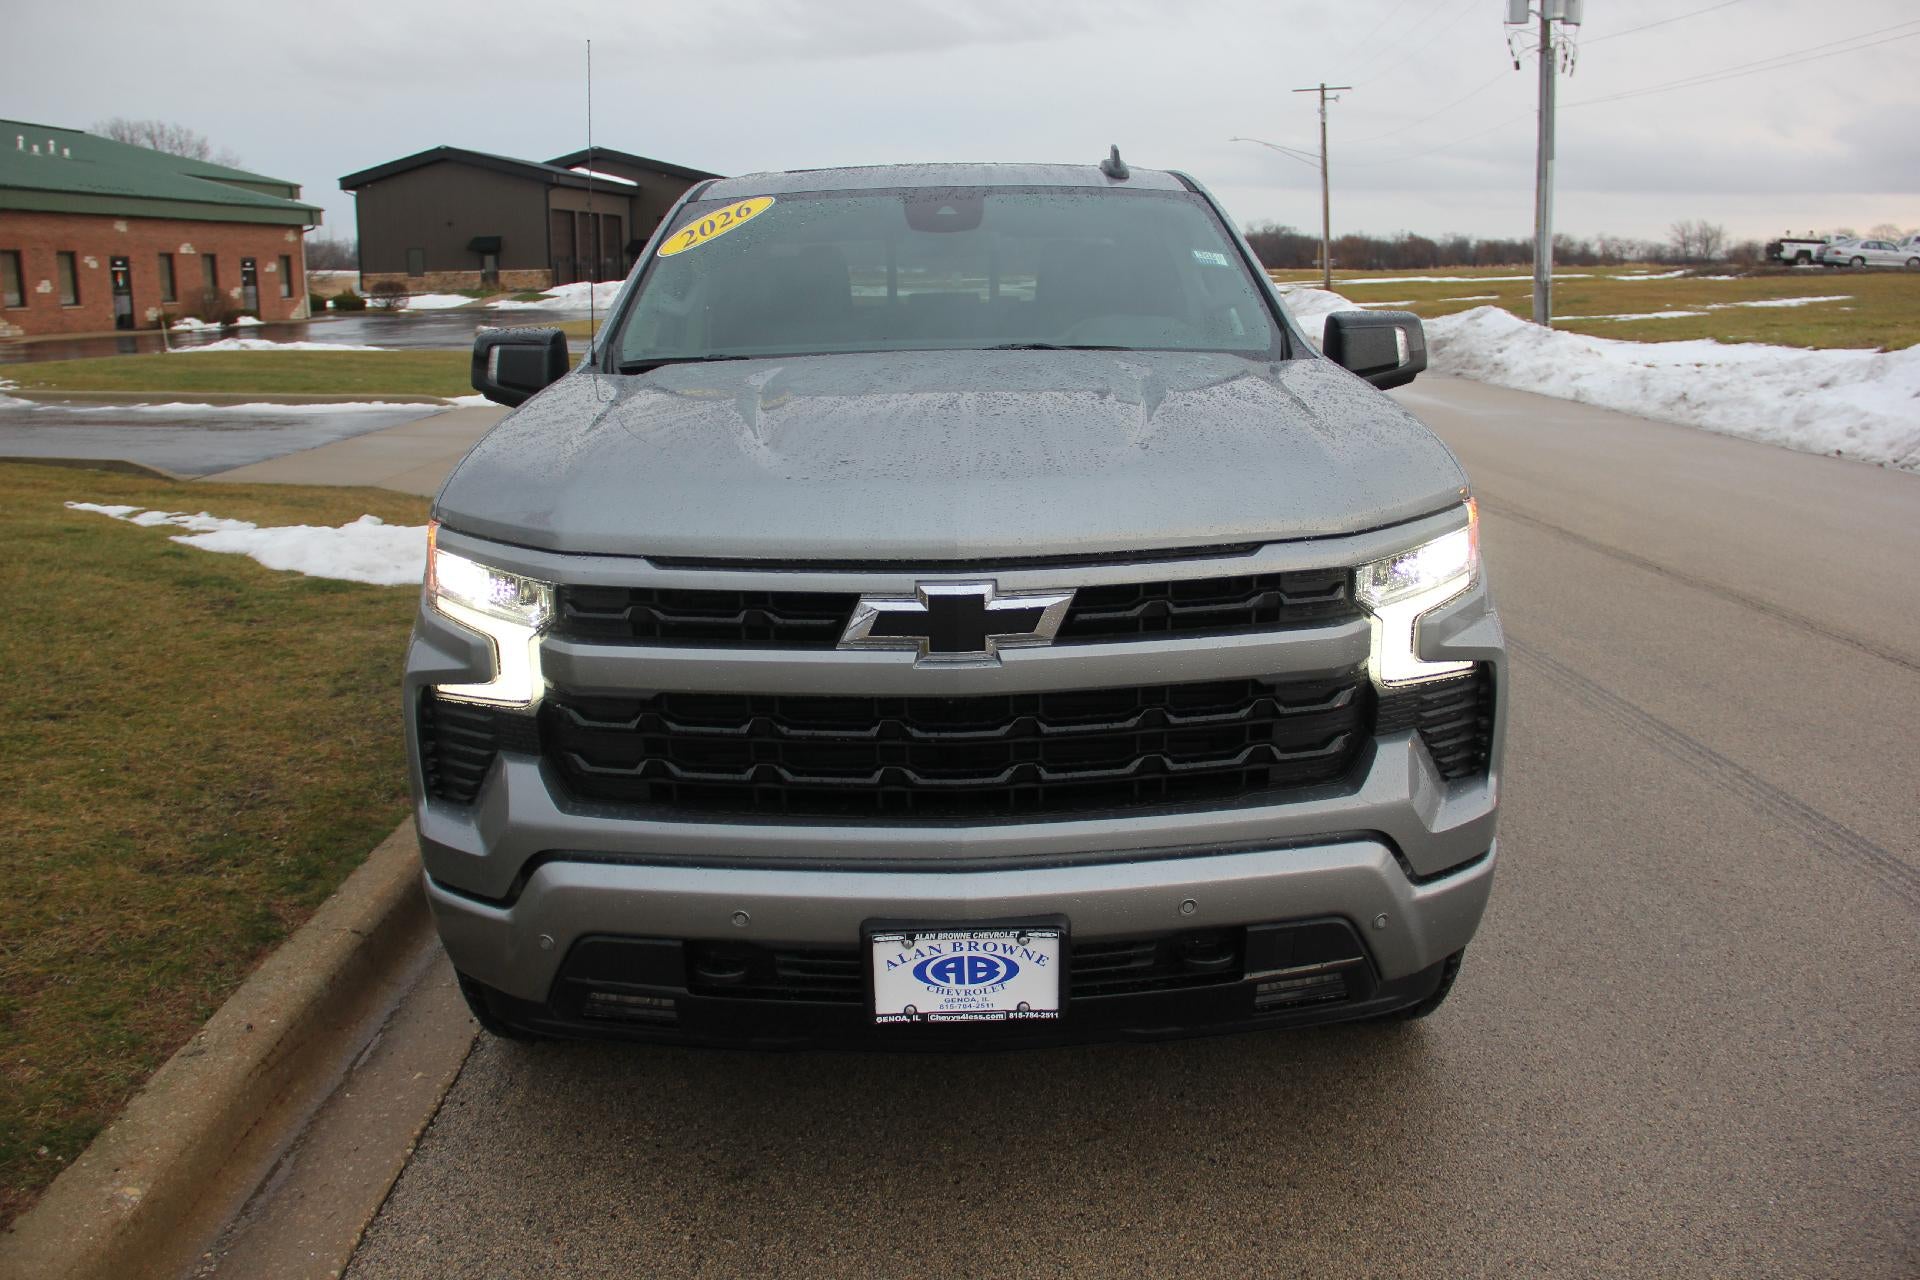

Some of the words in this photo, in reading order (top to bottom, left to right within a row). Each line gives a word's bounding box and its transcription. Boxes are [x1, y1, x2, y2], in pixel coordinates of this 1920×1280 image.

[681, 203, 751, 248] 2026
[972, 931, 1019, 939] CHEVROLET
[885, 943, 942, 971] ALAN
[951, 941, 1049, 967] BROWNE
[926, 984, 1006, 996] CHEVROLET
[876, 1015, 910, 1023] GENOA,
